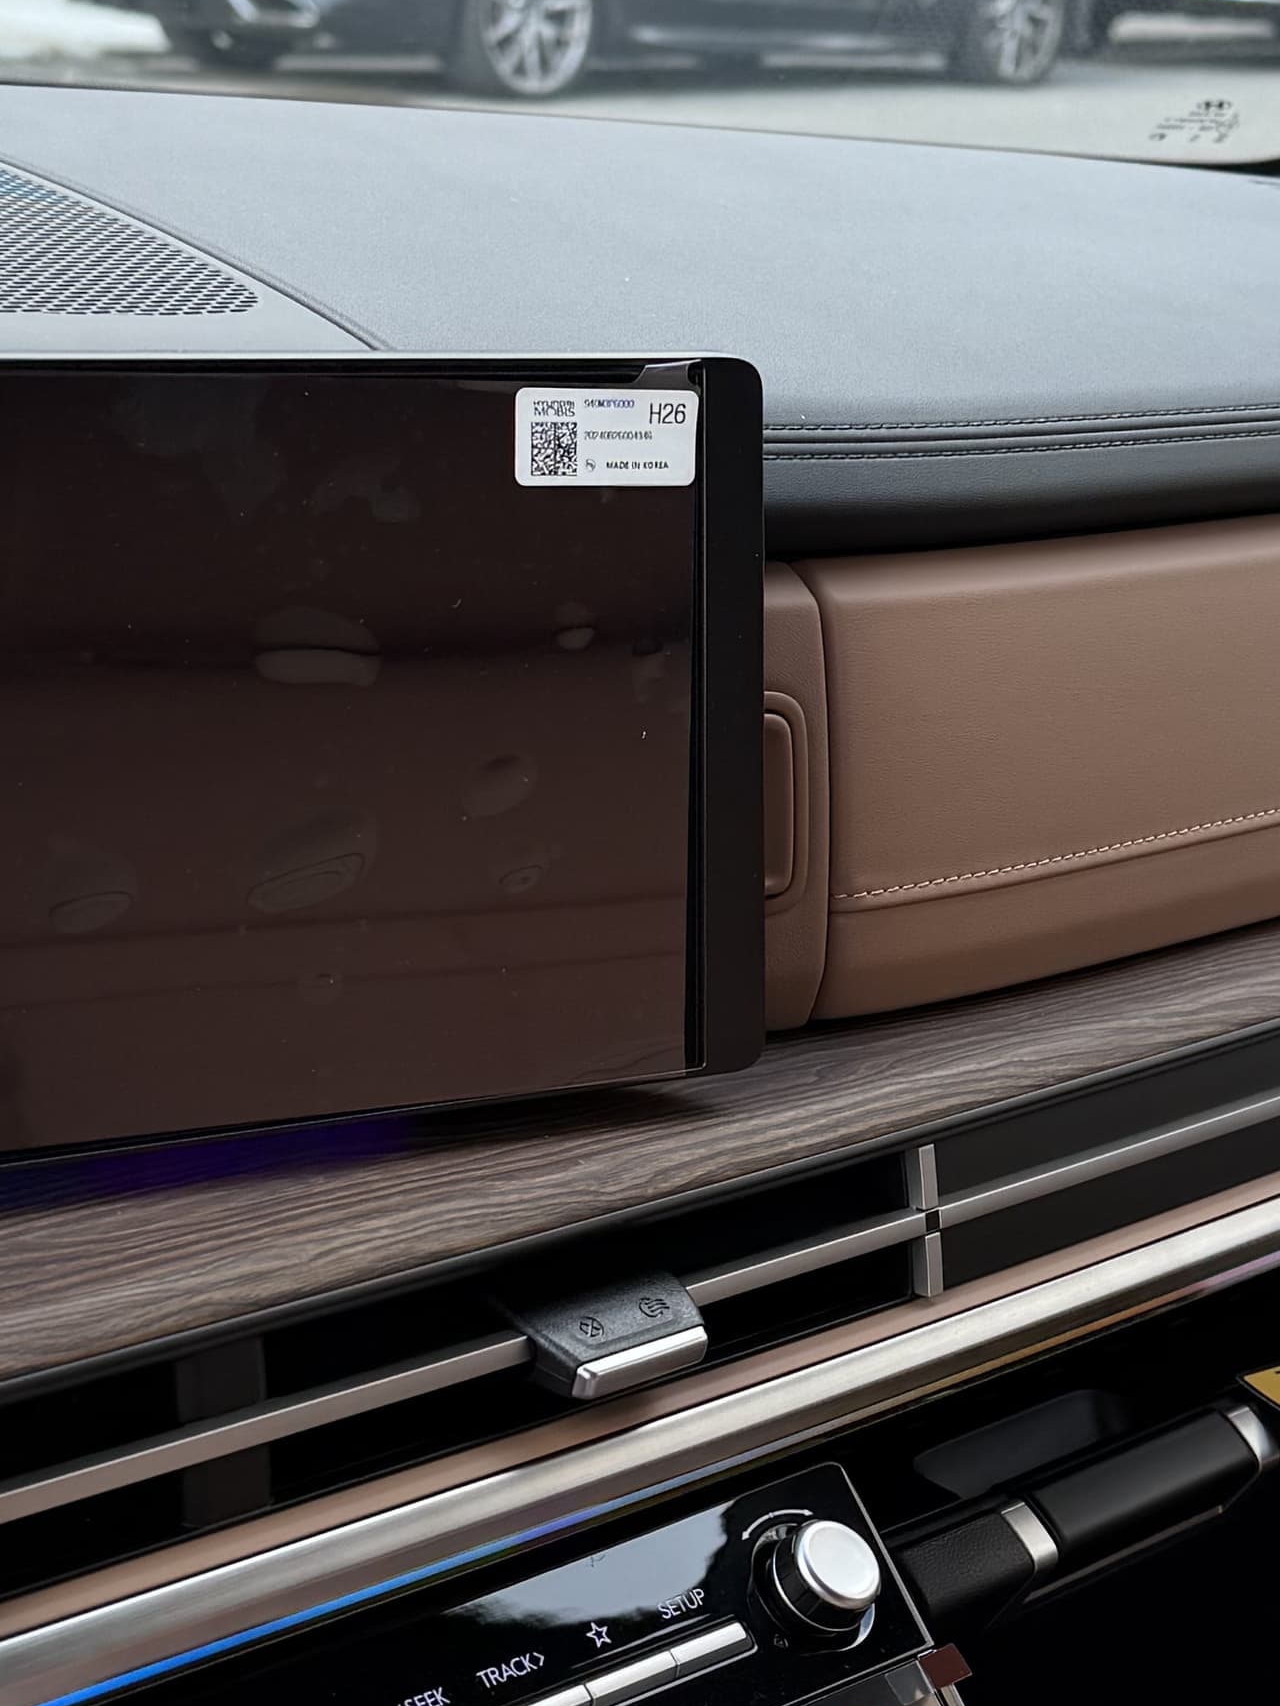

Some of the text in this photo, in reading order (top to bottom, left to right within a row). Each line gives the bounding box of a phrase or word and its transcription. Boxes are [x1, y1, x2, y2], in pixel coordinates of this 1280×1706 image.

[649, 402, 687, 425] H26
[606, 461, 669, 469] MADE IN KOREA
[656, 1588, 706, 1621] SETUP
